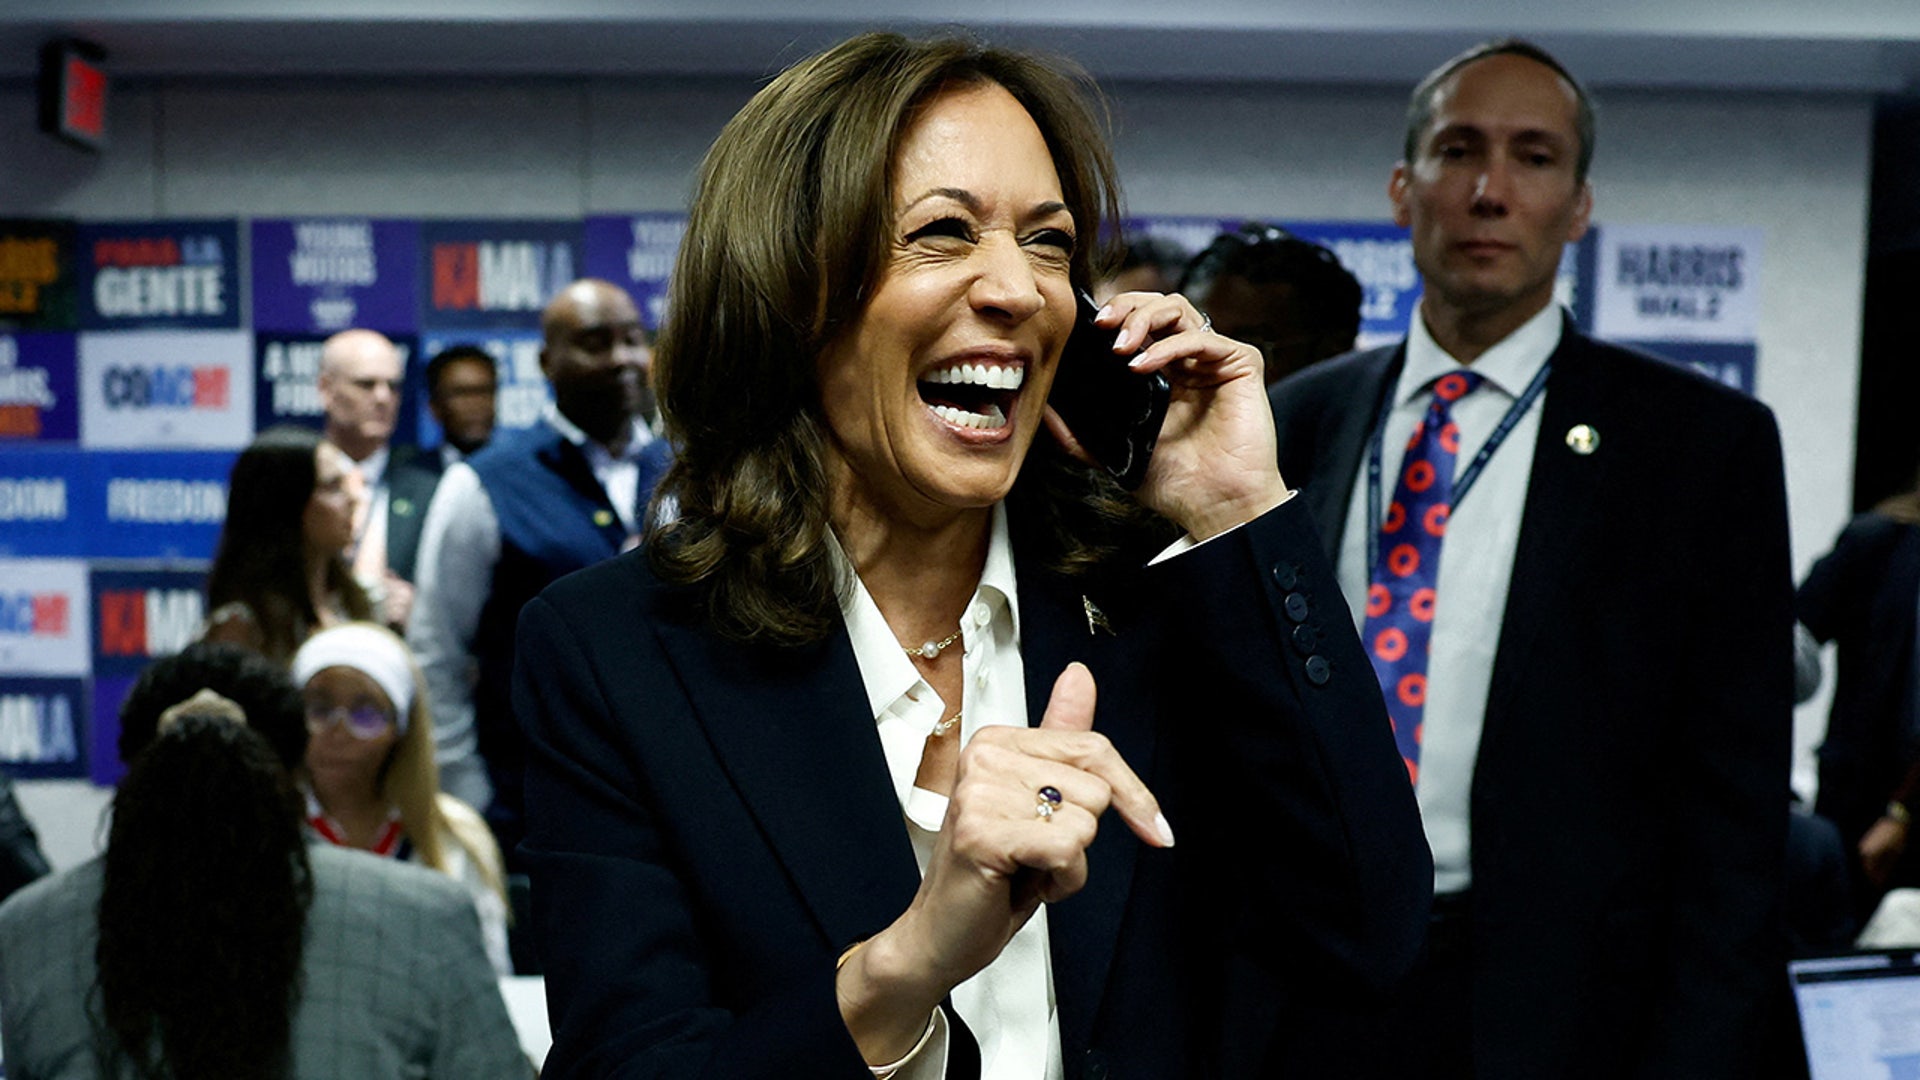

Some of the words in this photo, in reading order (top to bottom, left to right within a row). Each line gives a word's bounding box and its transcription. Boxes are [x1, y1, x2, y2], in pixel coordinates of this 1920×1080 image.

[432, 242, 575, 311] KAMALA
[1617, 246, 1744, 286] HARRIS
[95, 267, 227, 317] GENTE
[1636, 295, 1720, 319] WALZ
